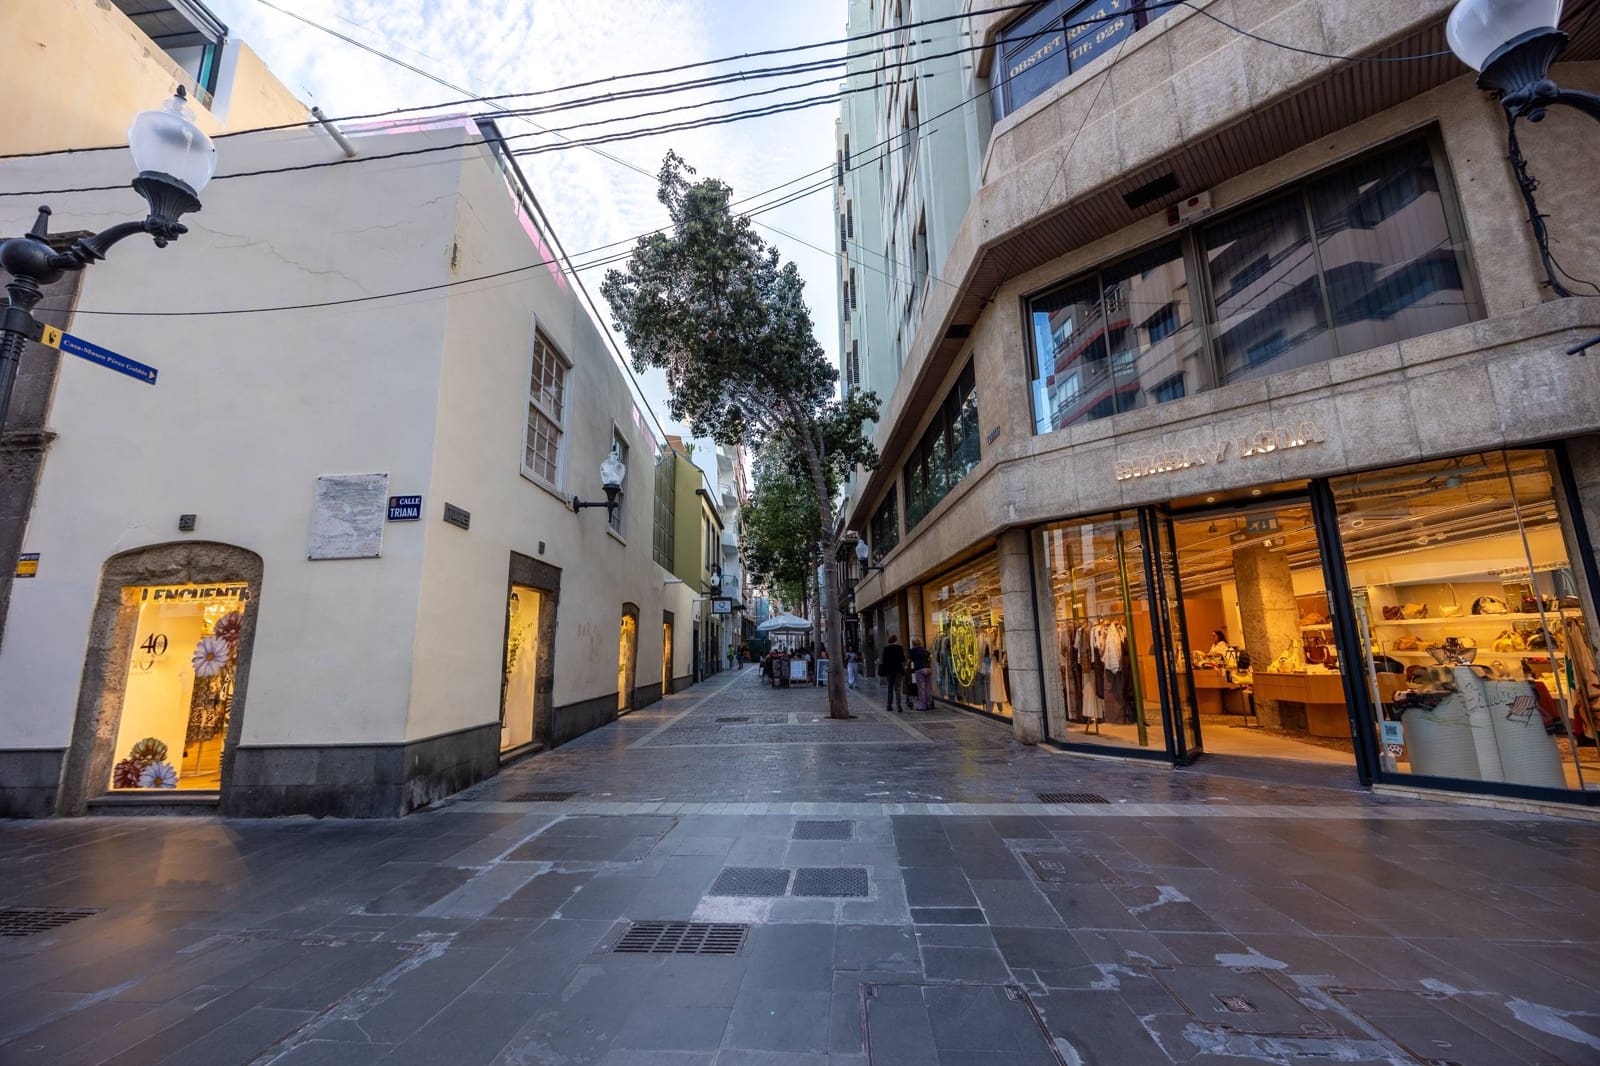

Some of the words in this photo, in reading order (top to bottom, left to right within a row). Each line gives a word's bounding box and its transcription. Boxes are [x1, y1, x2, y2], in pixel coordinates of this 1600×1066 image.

[1095, 18, 1125, 44] 928
[1116, 447, 1206, 481] BIMBA
[1208, 440, 1229, 464] Y
[1235, 422, 1325, 458] LOLA
[389, 507, 418, 518] TRIANA
[399, 497, 421, 505] CALLE
[140, 633, 168, 656] 40
